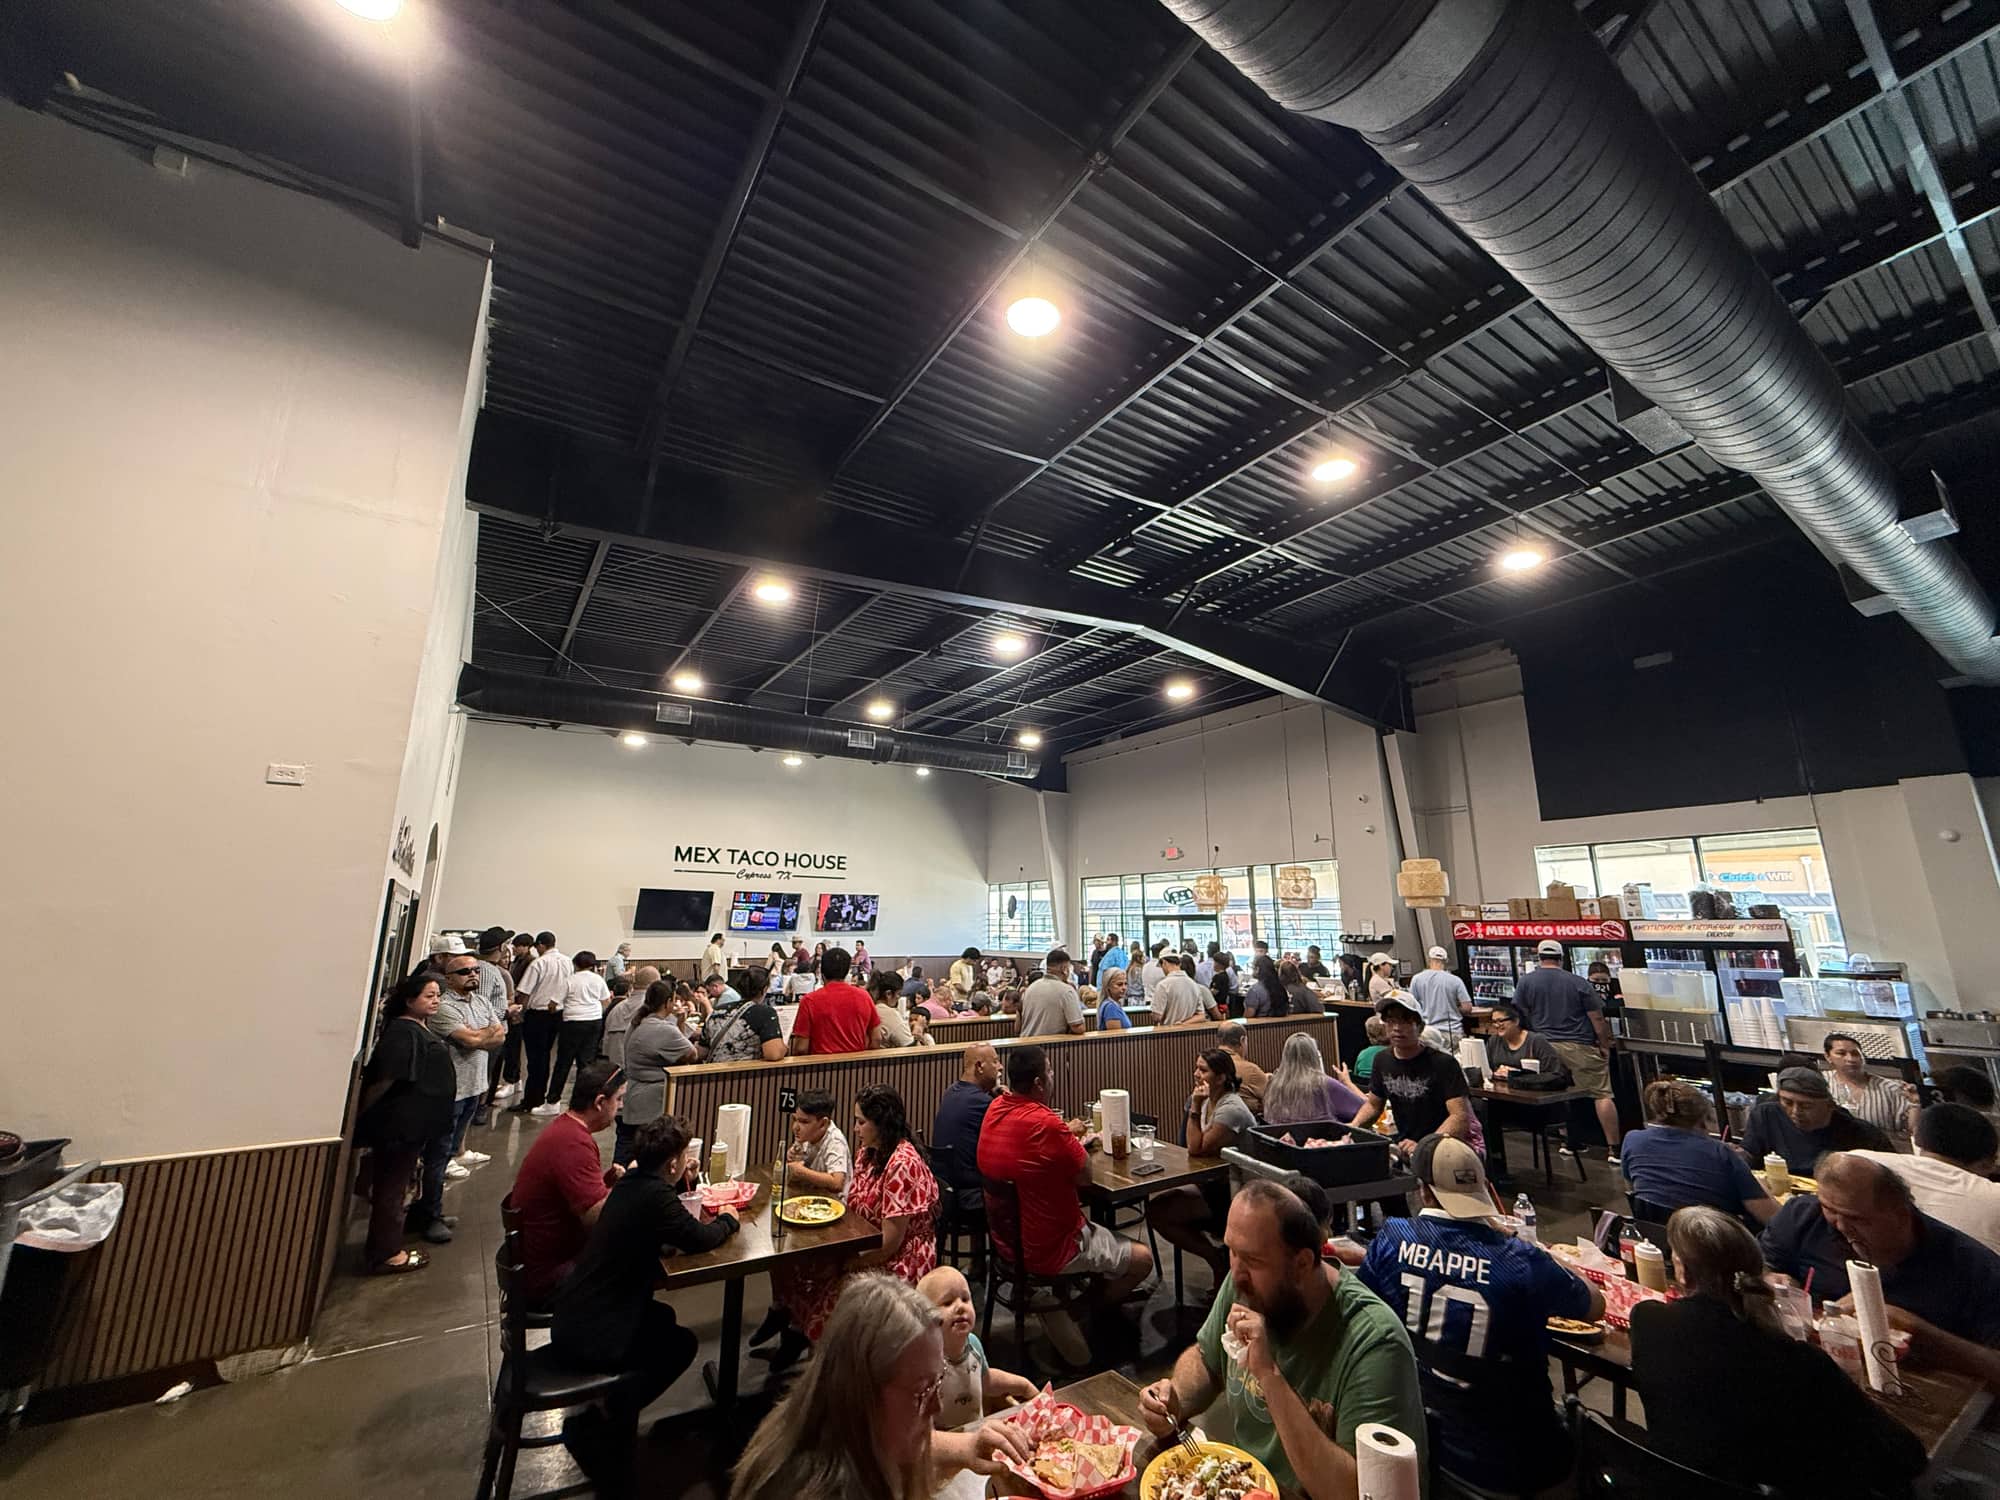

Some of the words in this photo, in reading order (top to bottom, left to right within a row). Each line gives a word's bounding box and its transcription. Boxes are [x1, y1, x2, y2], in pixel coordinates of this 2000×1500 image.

[674, 845, 721, 864] MEX
[727, 848, 779, 866] TACO
[784, 852, 847, 870] HOUSE
[736, 869, 772, 880] Cypress
[776, 870, 792, 880] TX
[1485, 925, 1514, 936] MEX
[1517, 925, 1553, 936] TACO
[1557, 925, 1602, 936] HOUSE
[781, 1092, 796, 1108] 75
[1398, 1240, 1491, 1285] MBAPPE
[1400, 1272, 1490, 1358] 10
